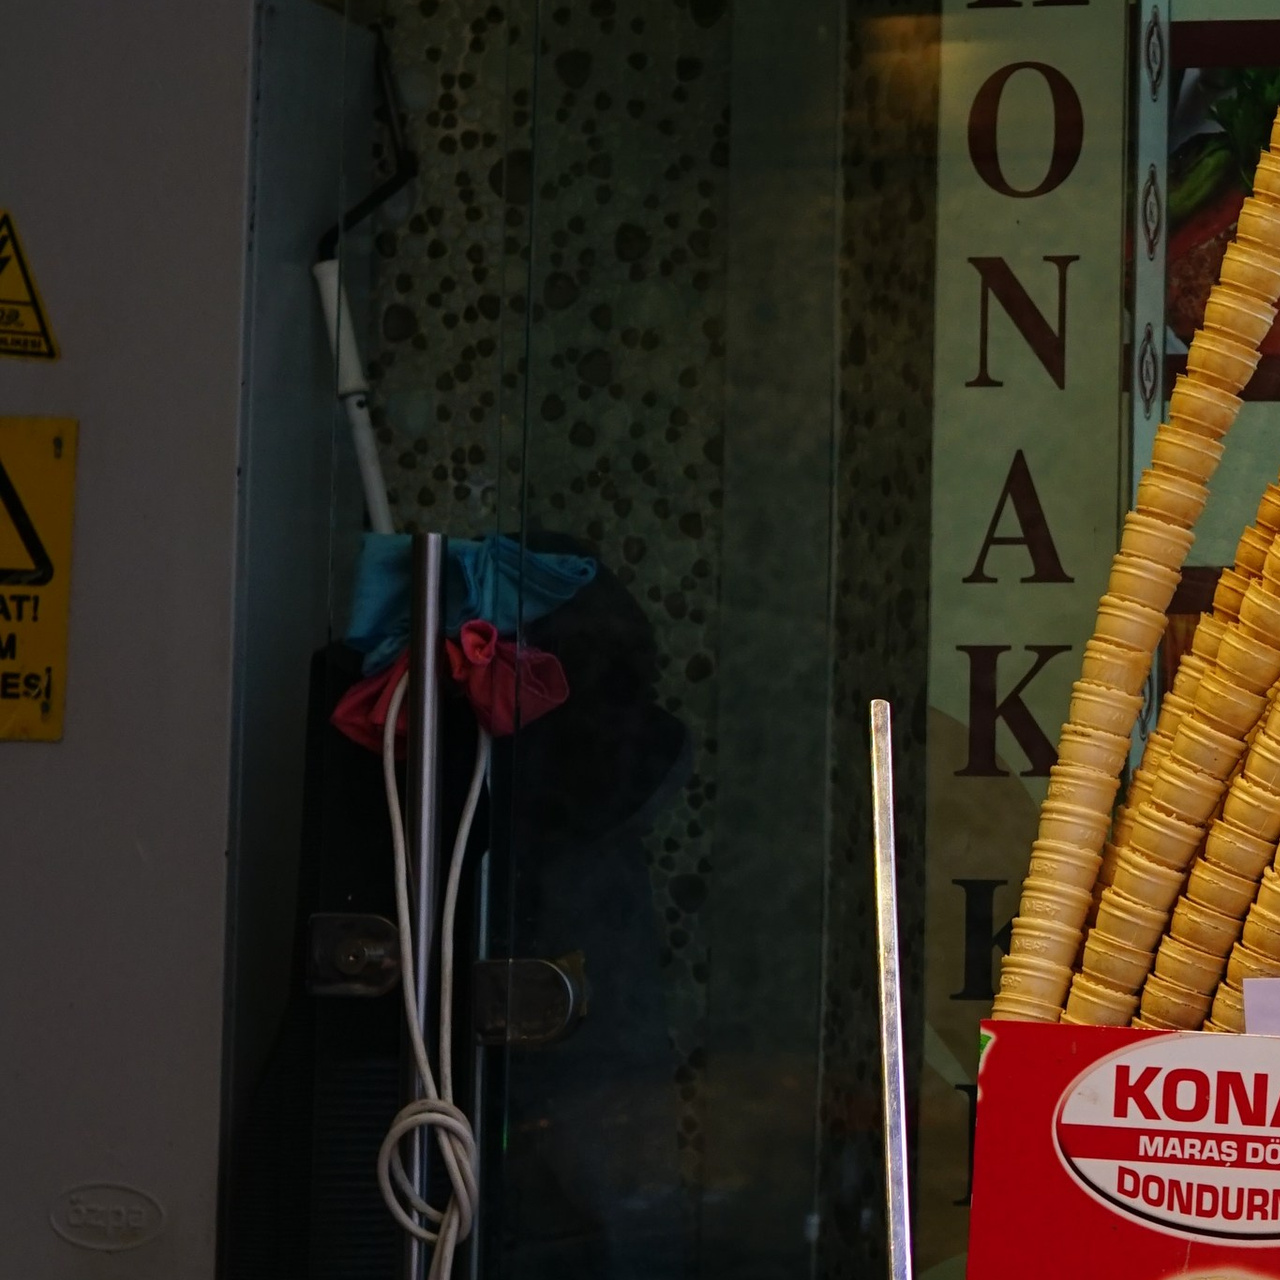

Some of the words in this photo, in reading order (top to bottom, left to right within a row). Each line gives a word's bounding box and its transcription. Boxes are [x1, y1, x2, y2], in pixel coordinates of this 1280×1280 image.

[1023, 899, 1062, 917] MERT
[1013, 938, 1050, 955] MERT
[1138, 1134, 1238, 1168] MARAŞ
